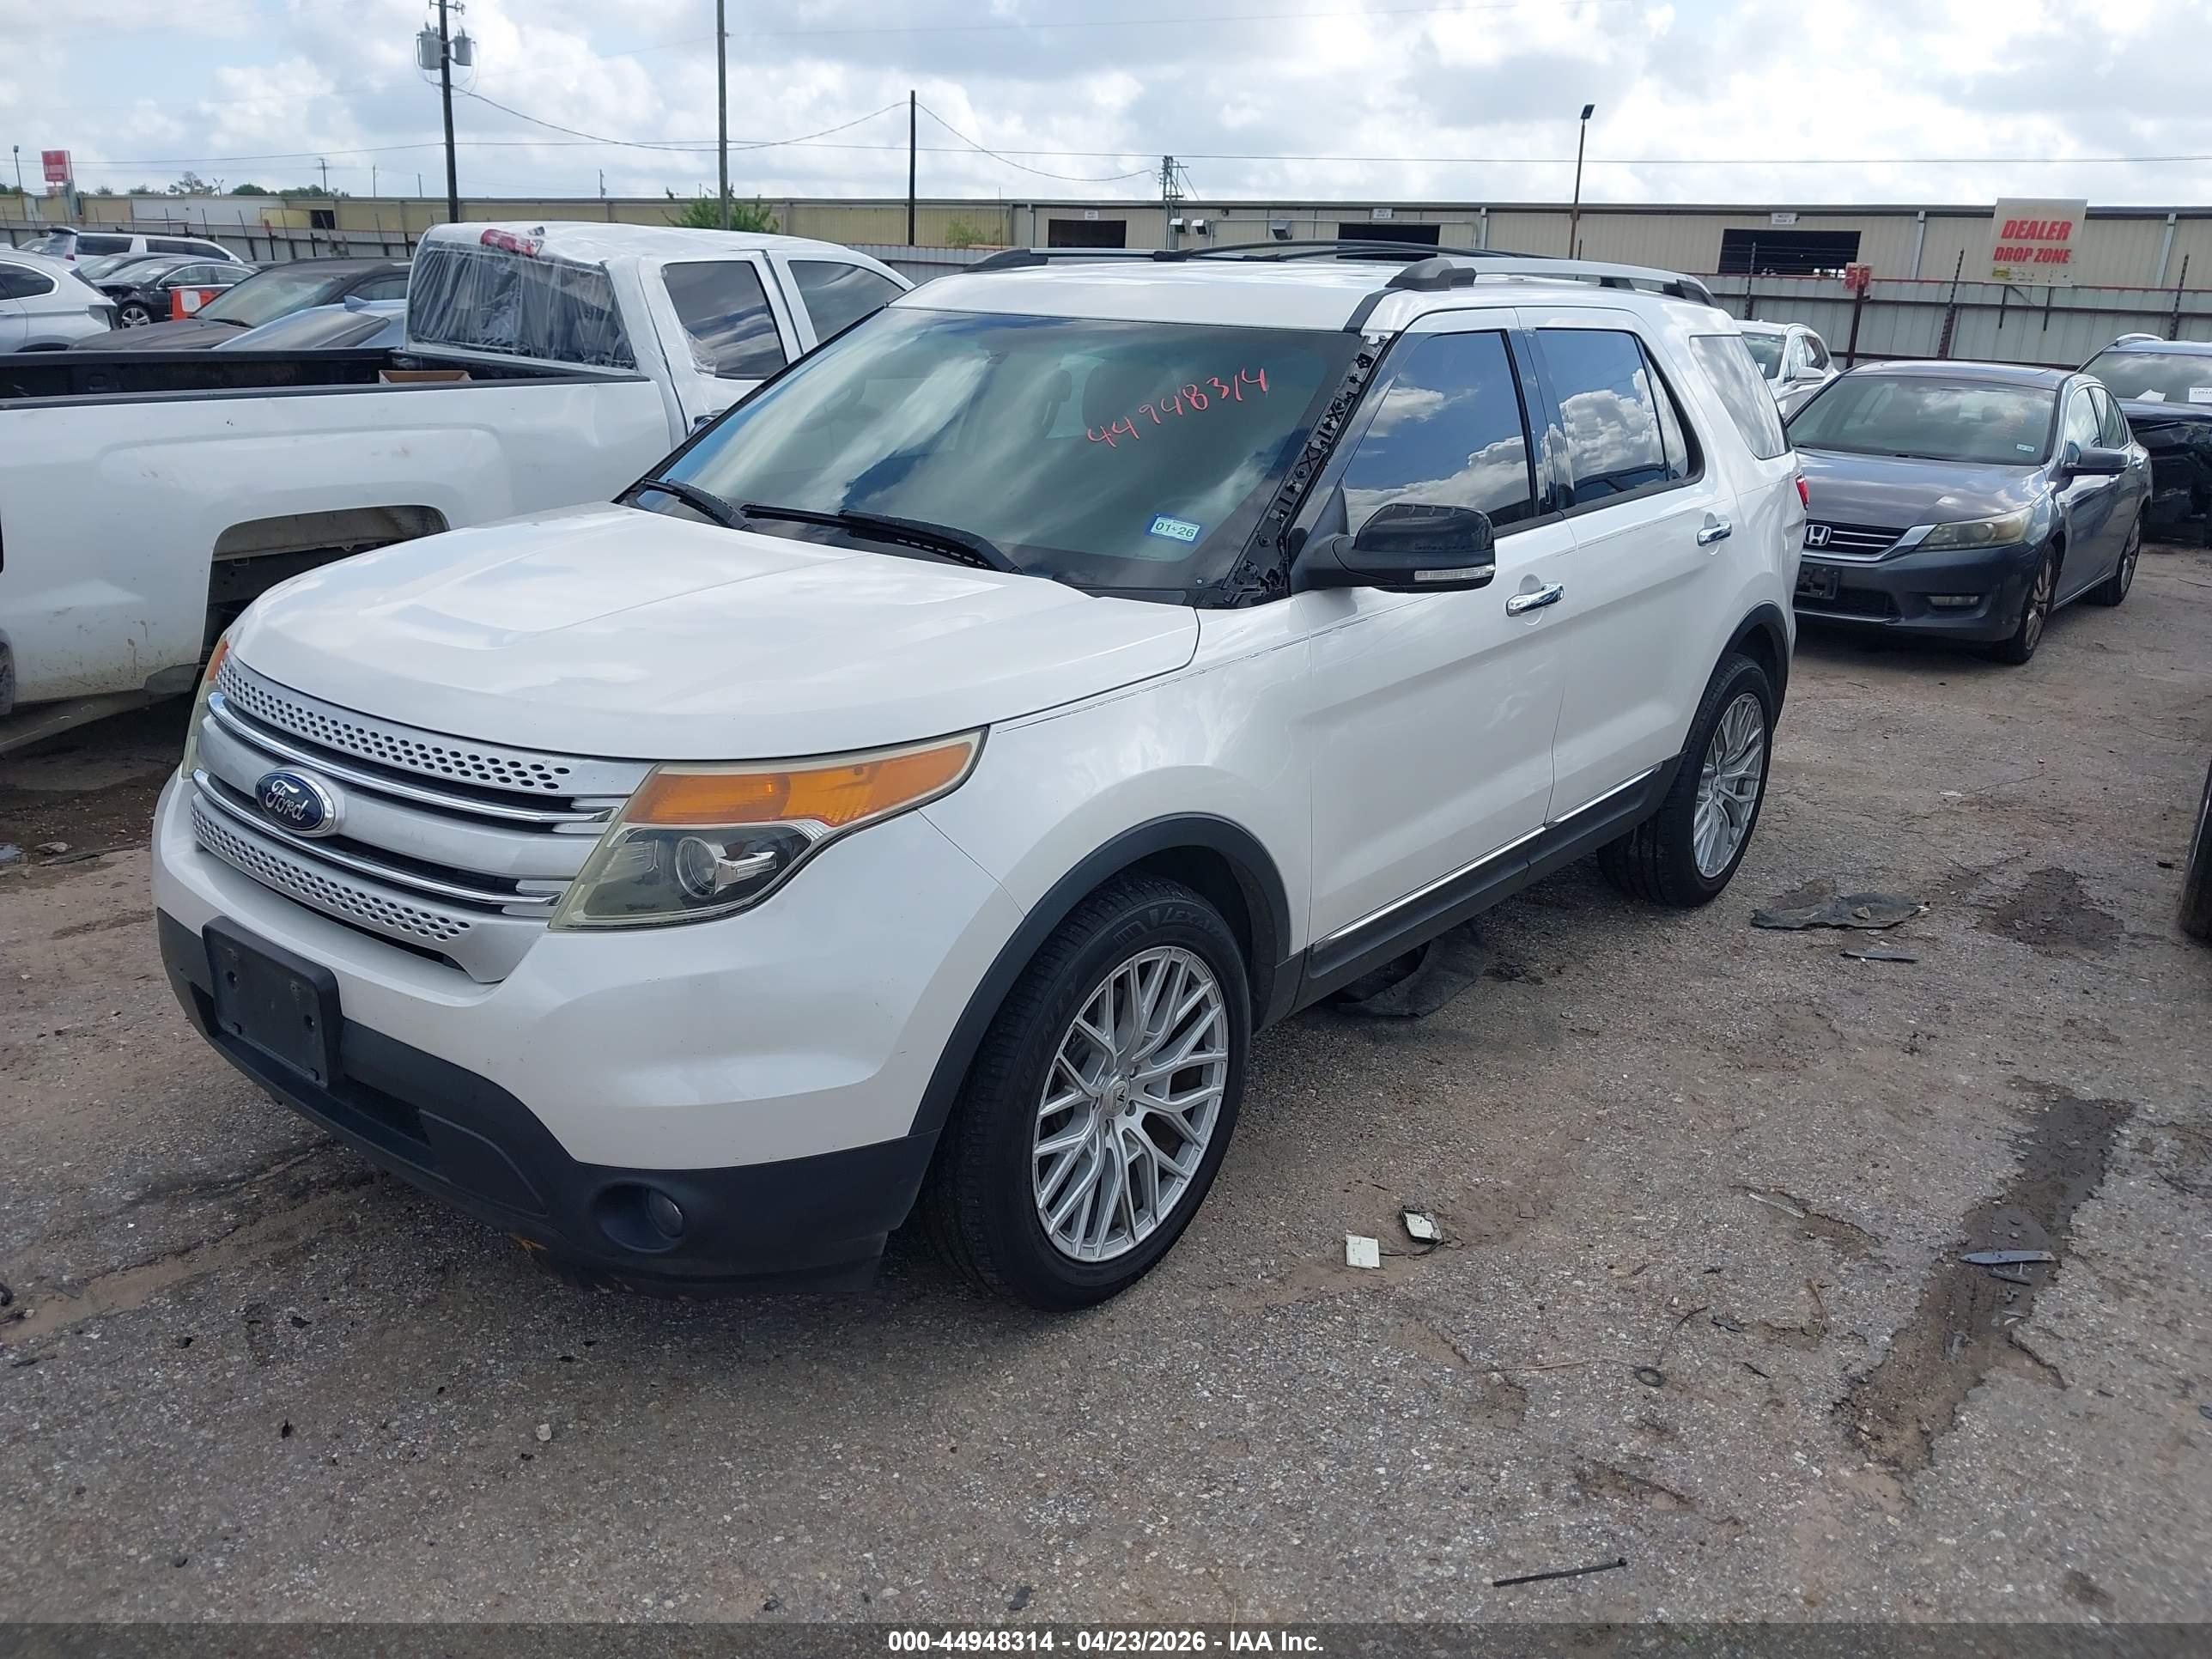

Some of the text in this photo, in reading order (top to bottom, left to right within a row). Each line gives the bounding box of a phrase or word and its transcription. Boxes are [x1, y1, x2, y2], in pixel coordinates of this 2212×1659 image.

[2001, 220, 2072, 240] DEALER
[1993, 246, 2071, 264] DROP ZONE
[1087, 368, 1268, 447] 44948314
[265, 780, 309, 820] Ford
